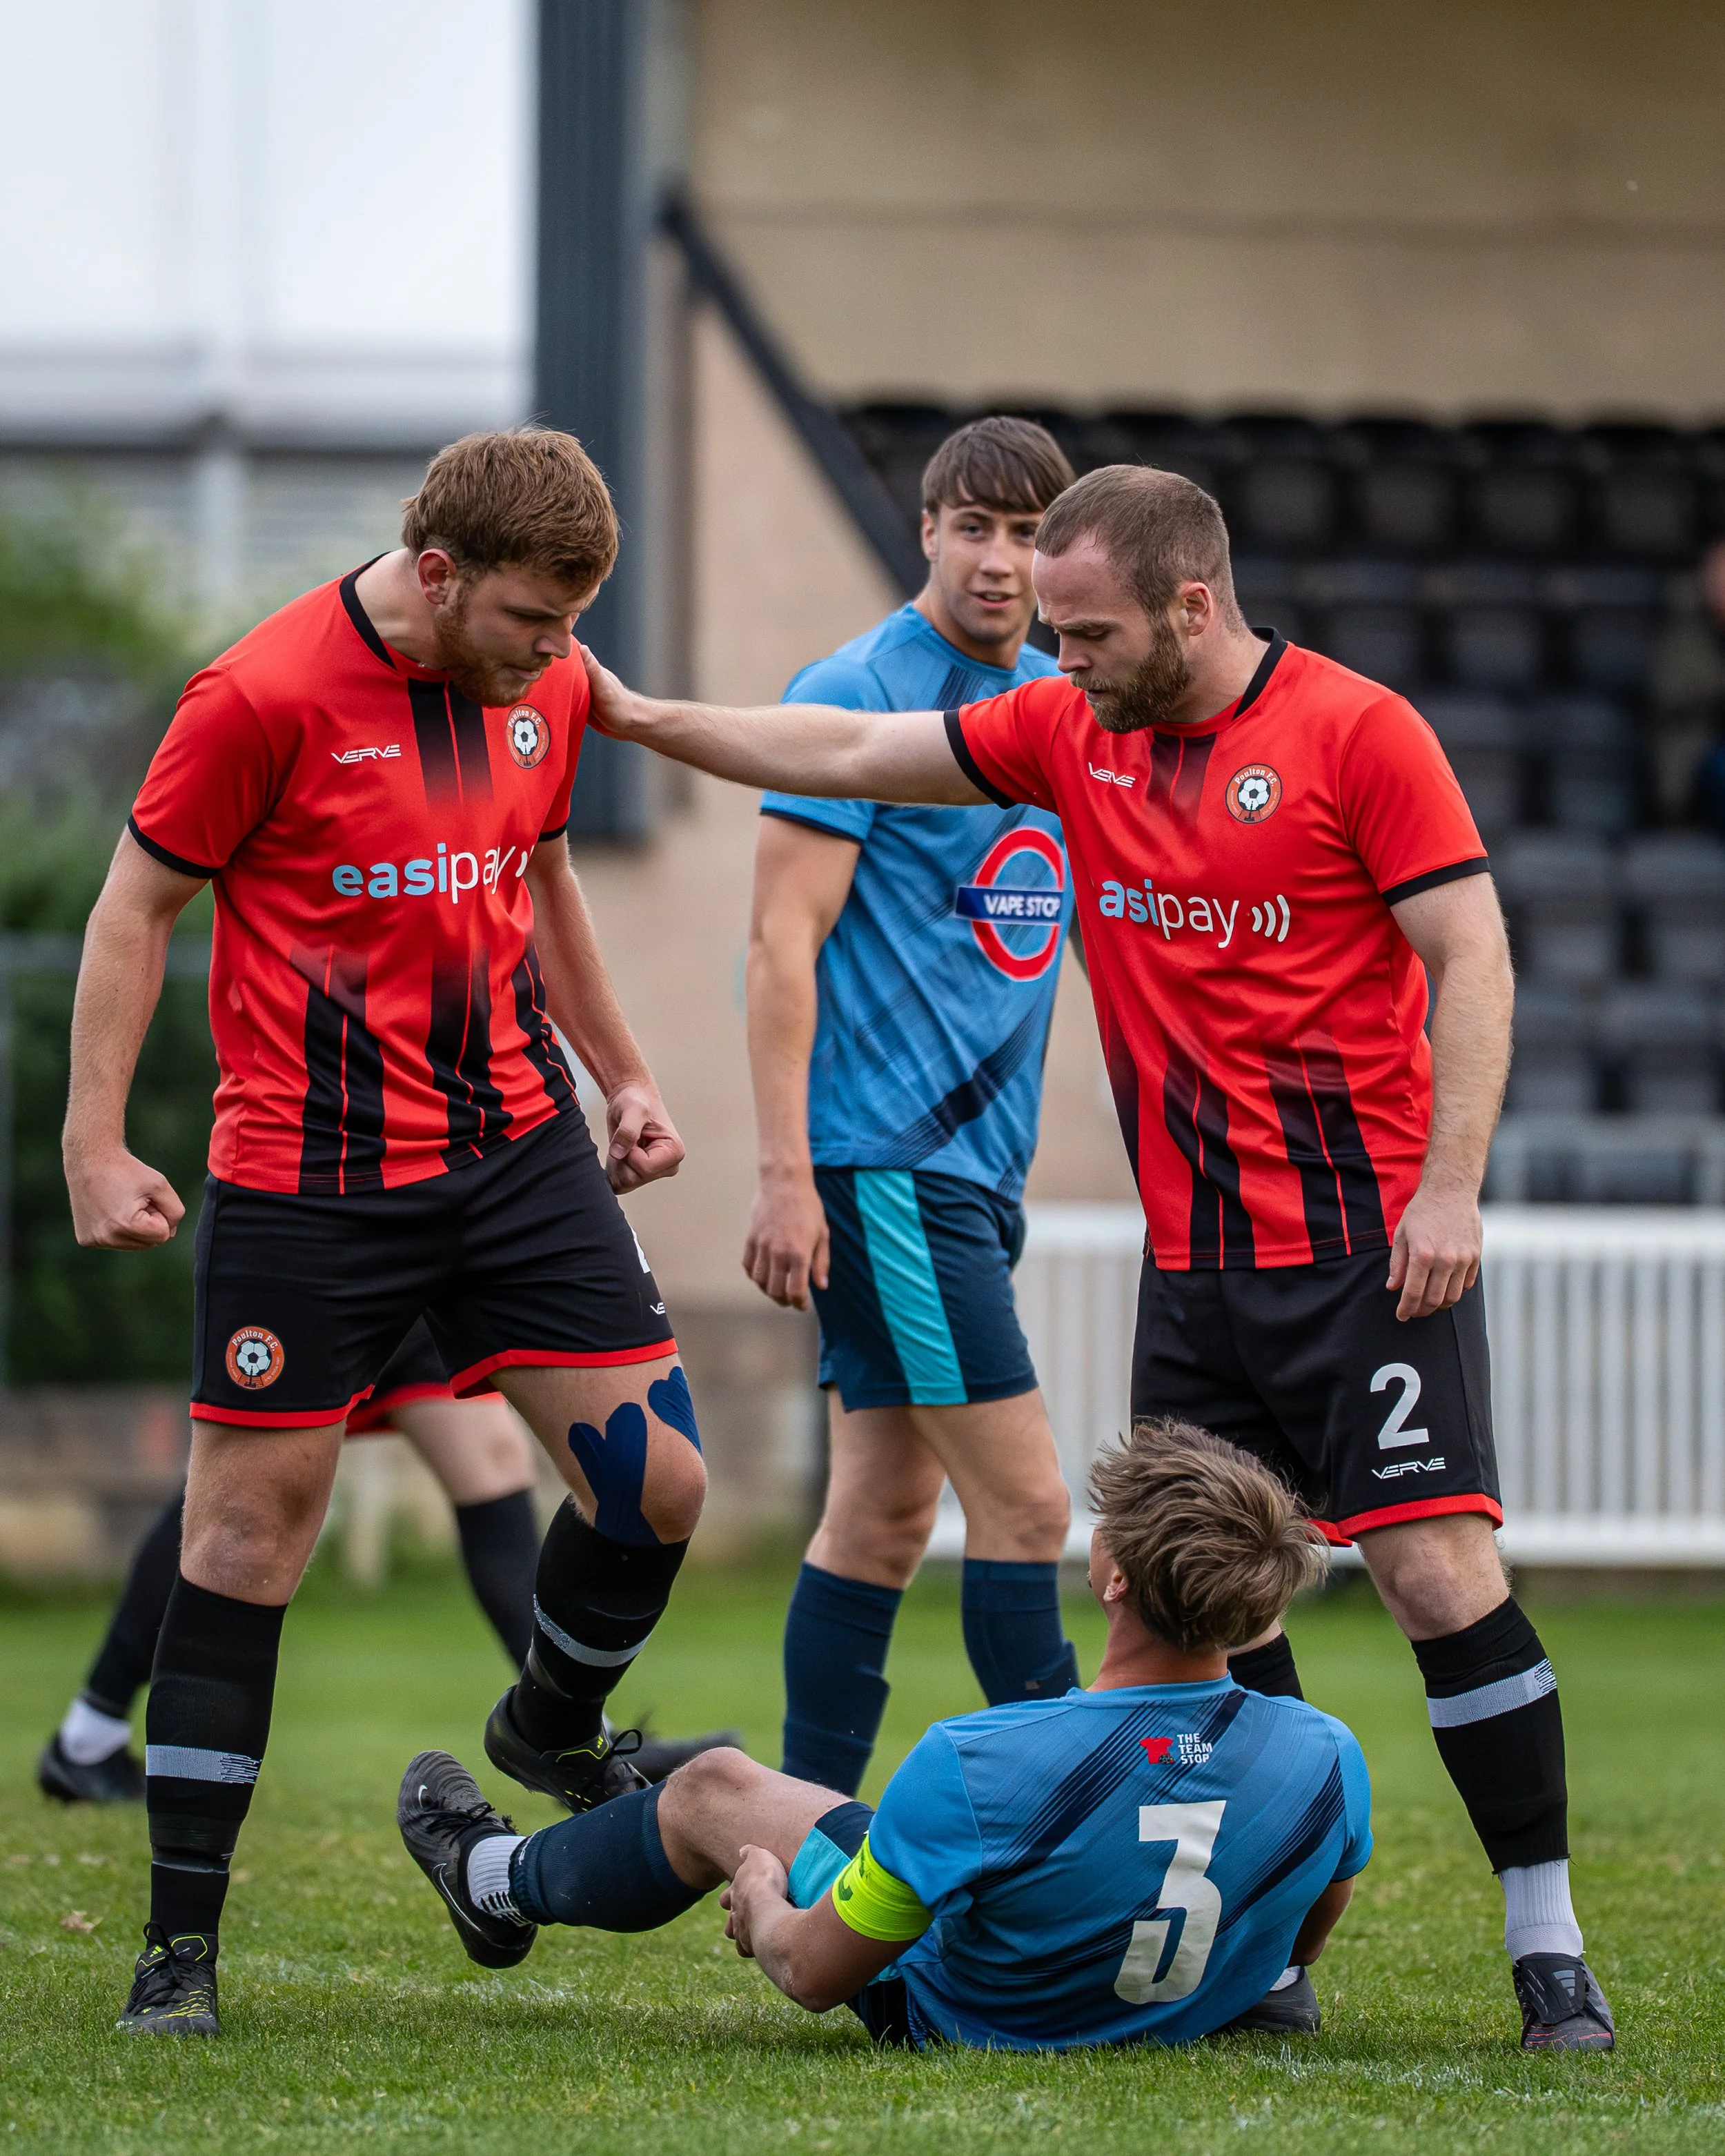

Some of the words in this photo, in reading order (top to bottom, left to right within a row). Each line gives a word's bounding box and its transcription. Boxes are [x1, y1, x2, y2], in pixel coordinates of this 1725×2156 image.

[508, 709, 529, 729] Poulton
[331, 744, 402, 764] VERVE
[1088, 761, 1136, 788] VERVE
[1234, 768, 1265, 784] Poulton
[1266, 772, 1277, 787] F.C.
[332, 842, 516, 904] easipay
[983, 893, 1025, 916] VAPE
[1026, 897, 1061, 918] STOP
[1098, 878, 1240, 949] asipay
[232, 1329, 264, 1347] Poulton
[265, 1335, 279, 1352] F.C.
[1370, 1363, 1430, 1450] 2
[1371, 1457, 1446, 1479] VERVE
[1176, 1732, 1201, 1744] THE
[1178, 1742, 1213, 1754] TEAM
[1181, 1753, 1210, 1765] STOP
[1114, 1800, 1227, 2005] 3
